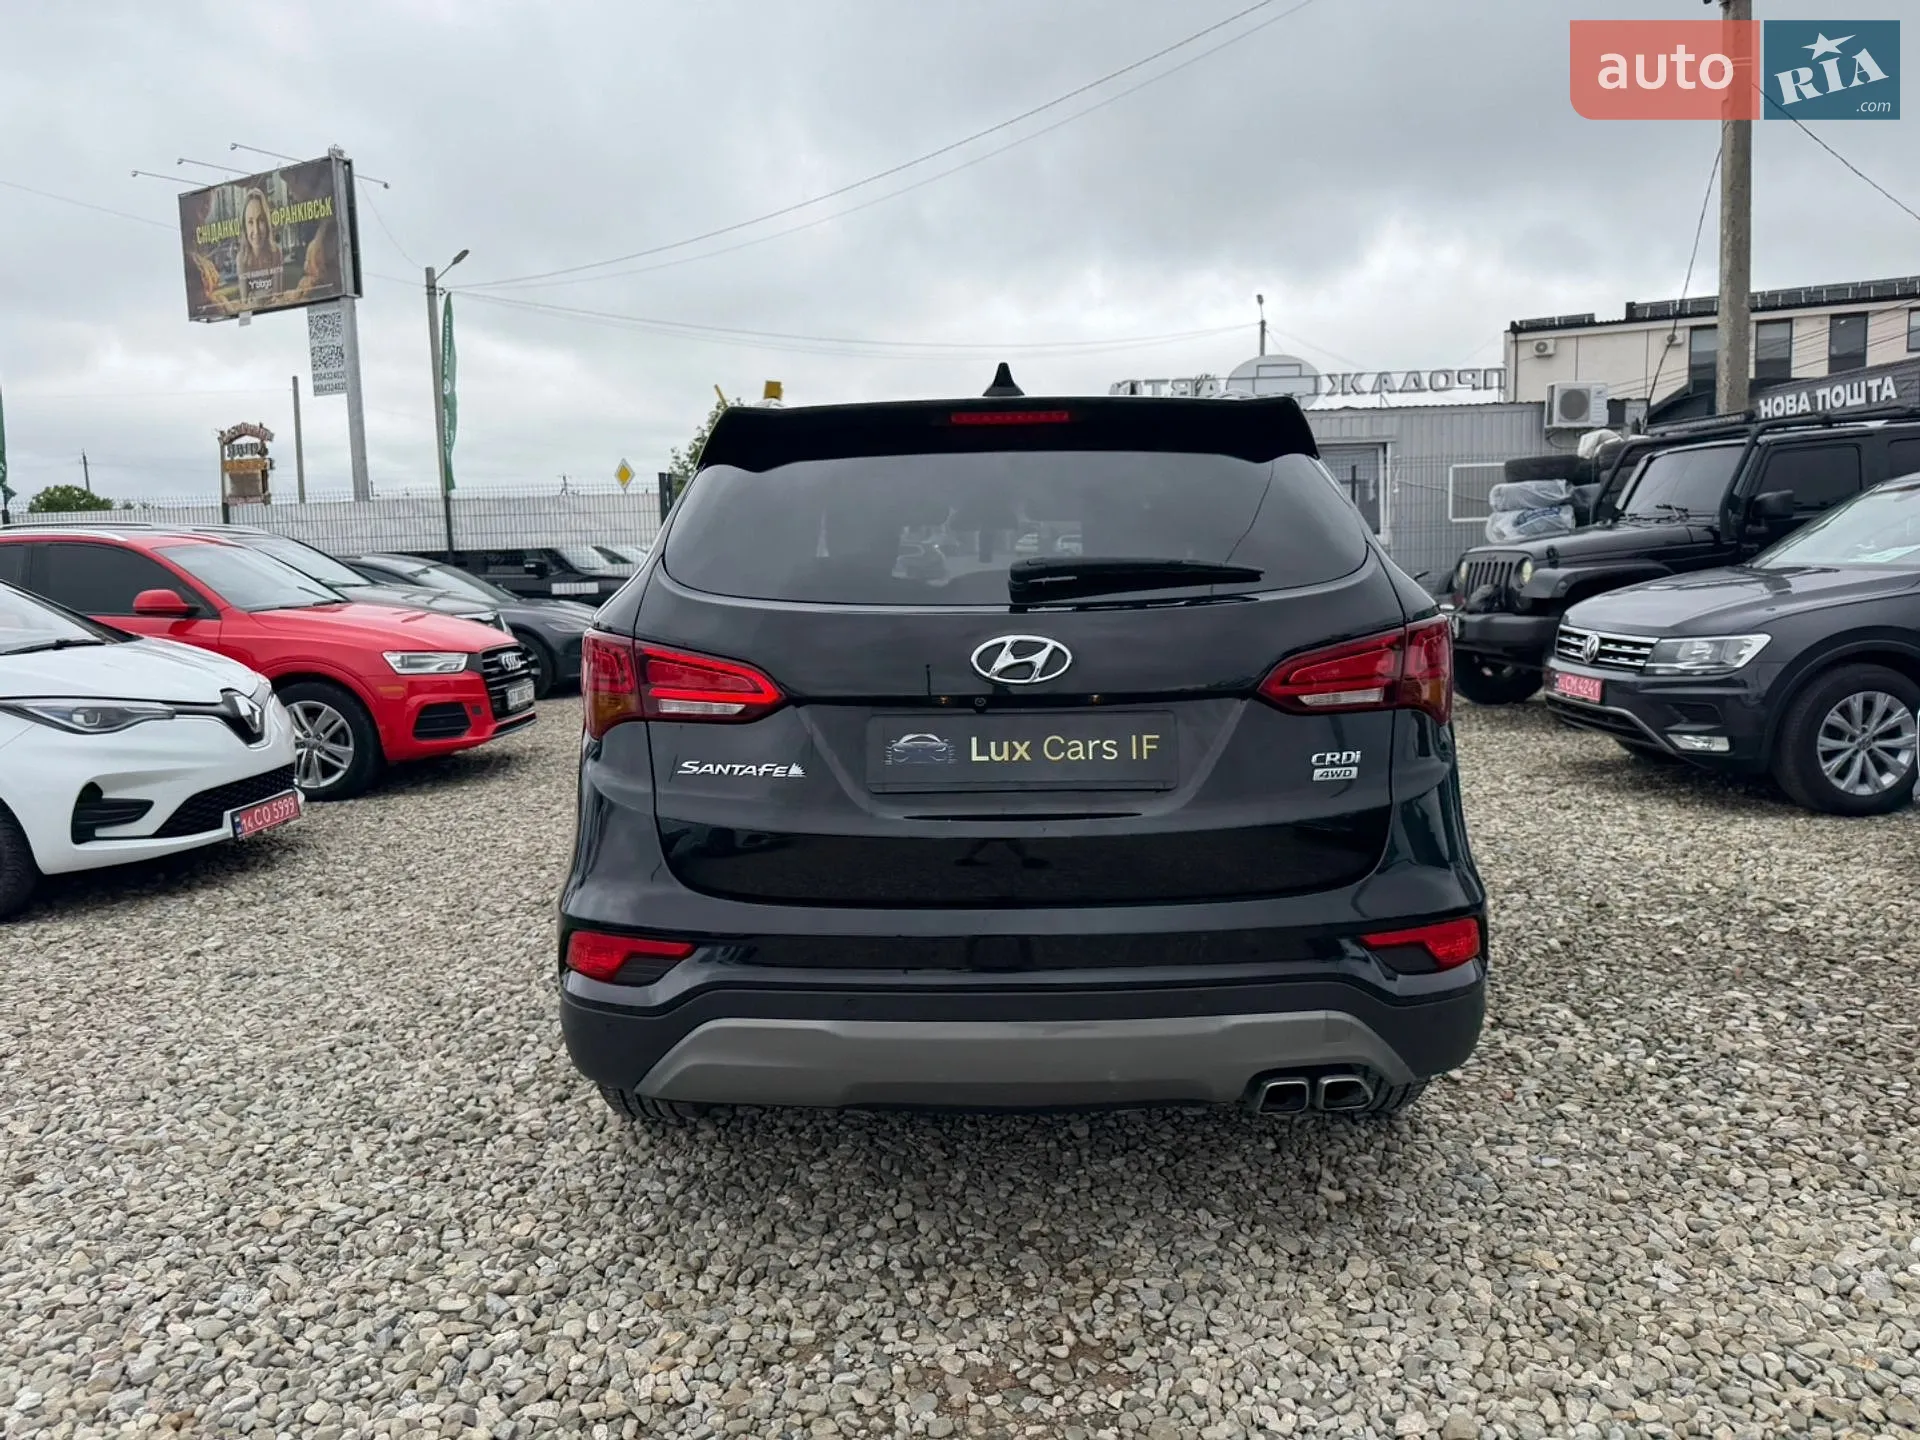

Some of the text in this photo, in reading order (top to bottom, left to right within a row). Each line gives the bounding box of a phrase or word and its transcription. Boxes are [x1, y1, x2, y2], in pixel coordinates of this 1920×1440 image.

[270, 197, 333, 226] ФРАНКІВСЬК
[1759, 376, 1897, 419] НОВА ПОШТА
[970, 735, 1160, 762] Lux Cars IF
[1311, 750, 1361, 766] CRDi
